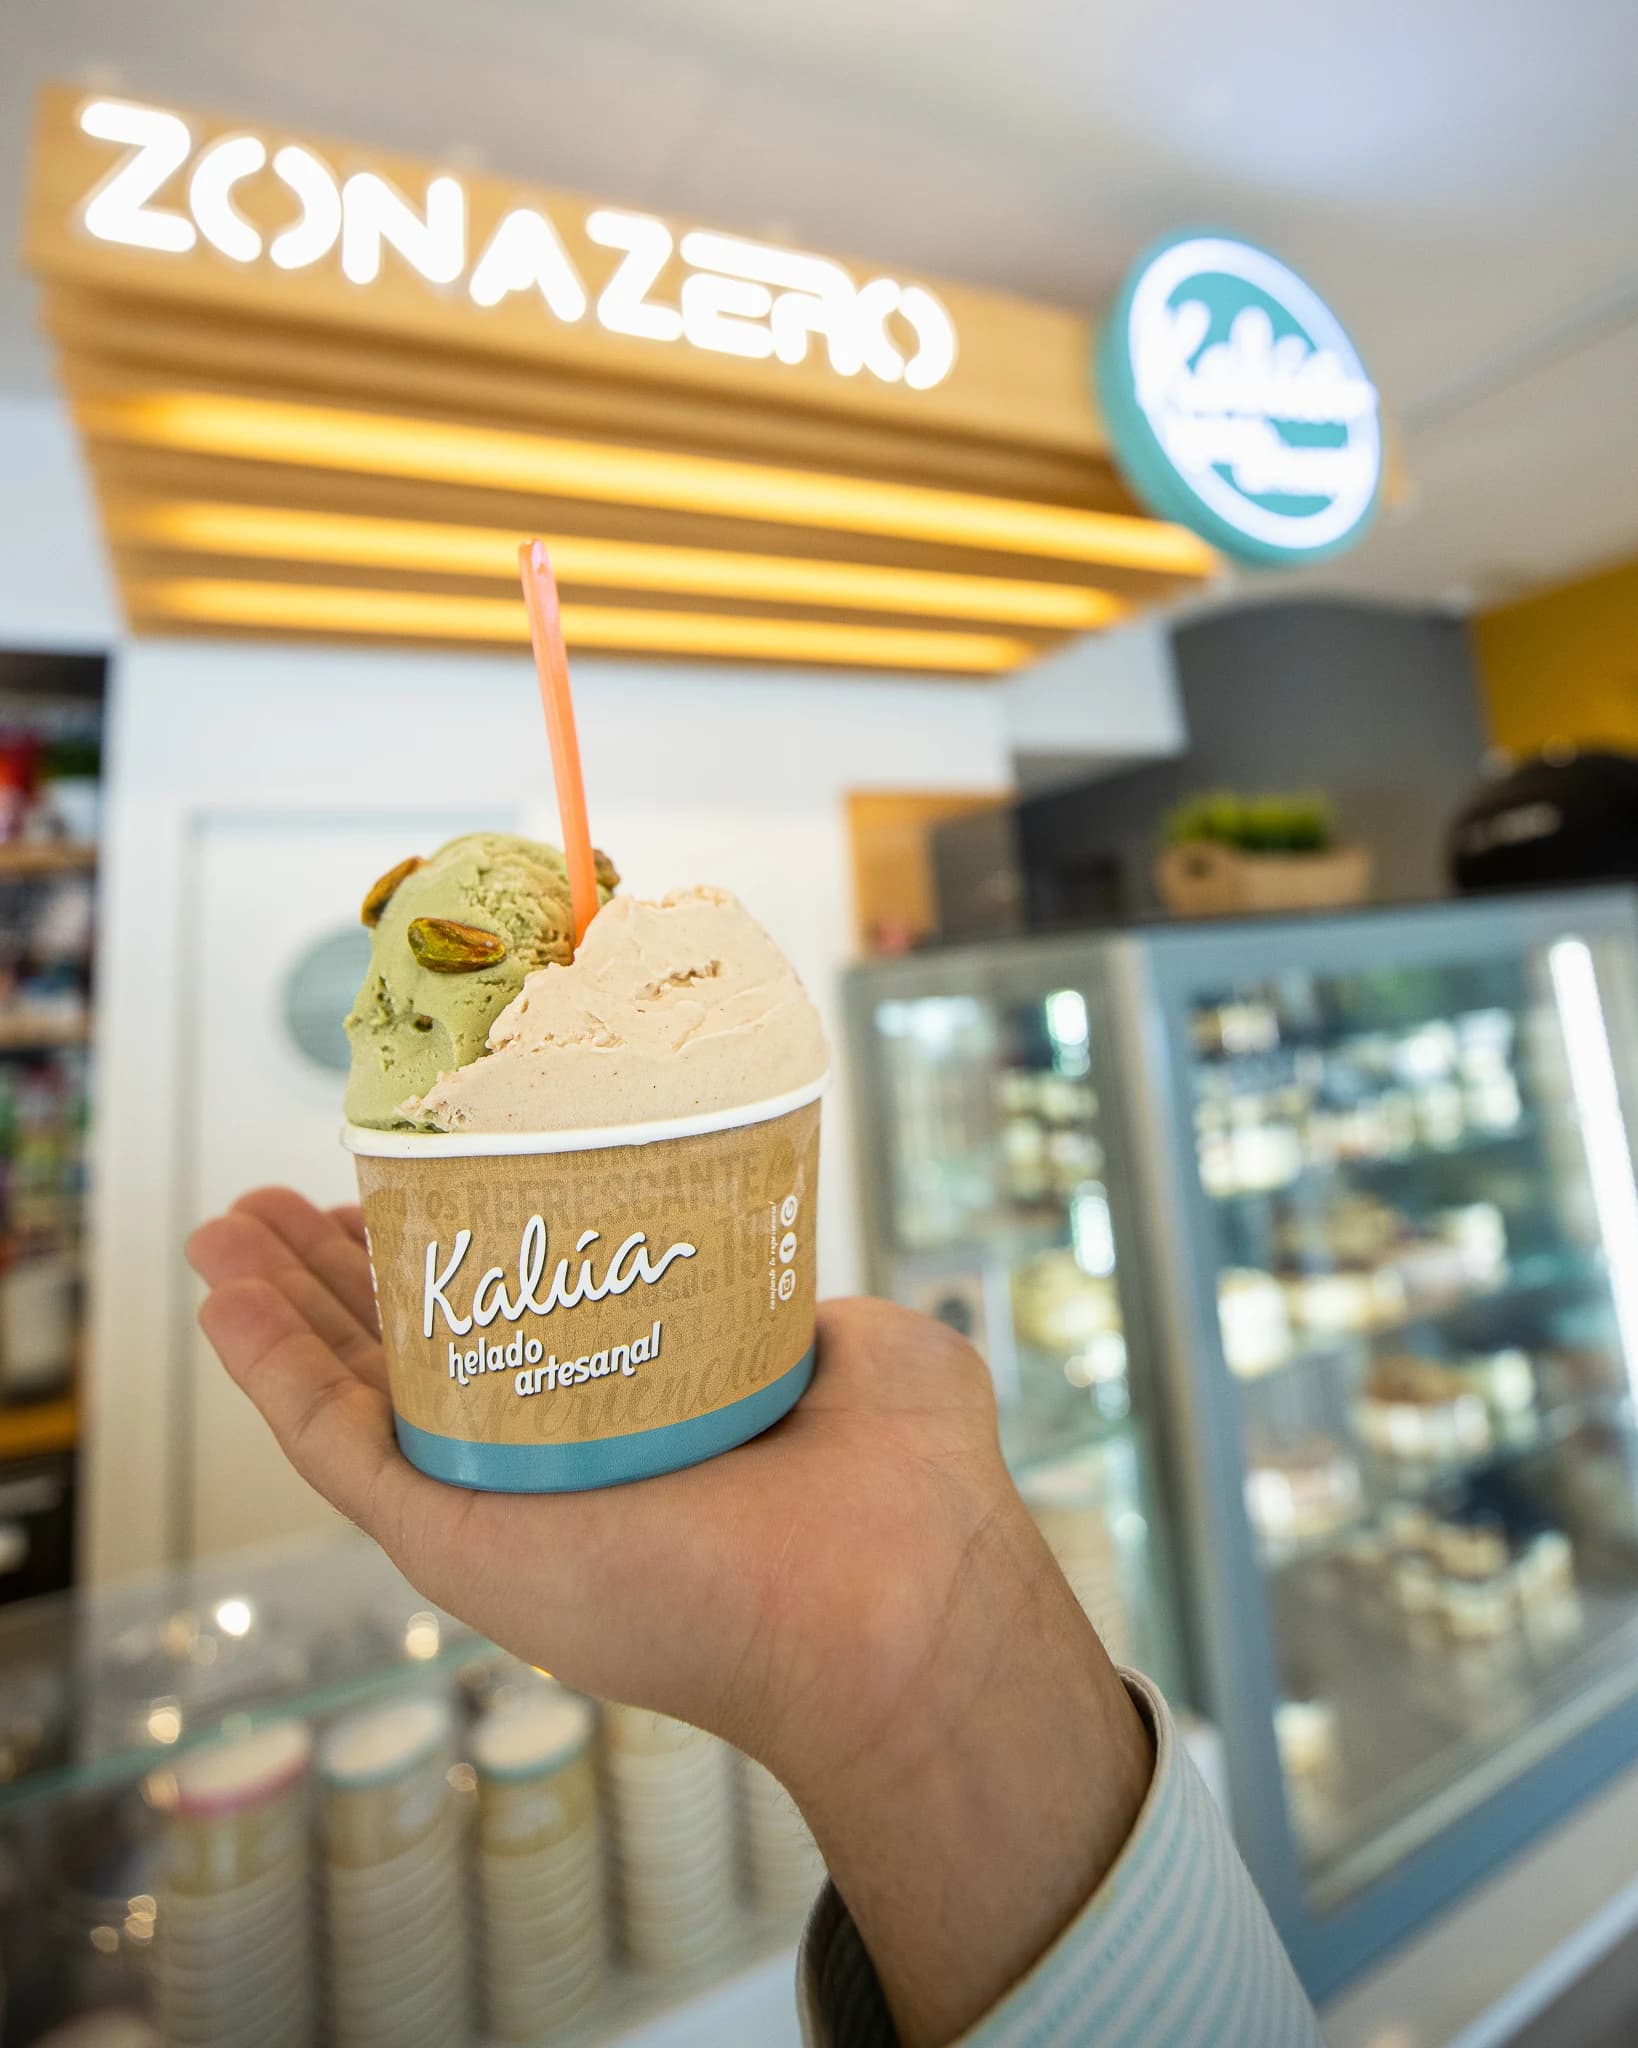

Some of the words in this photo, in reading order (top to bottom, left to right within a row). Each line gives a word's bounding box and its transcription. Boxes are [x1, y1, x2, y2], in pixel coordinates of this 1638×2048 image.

[423, 1214, 697, 1339] Kalúa
[448, 1330, 544, 1386] helado
[514, 1321, 662, 1397] artesanal
